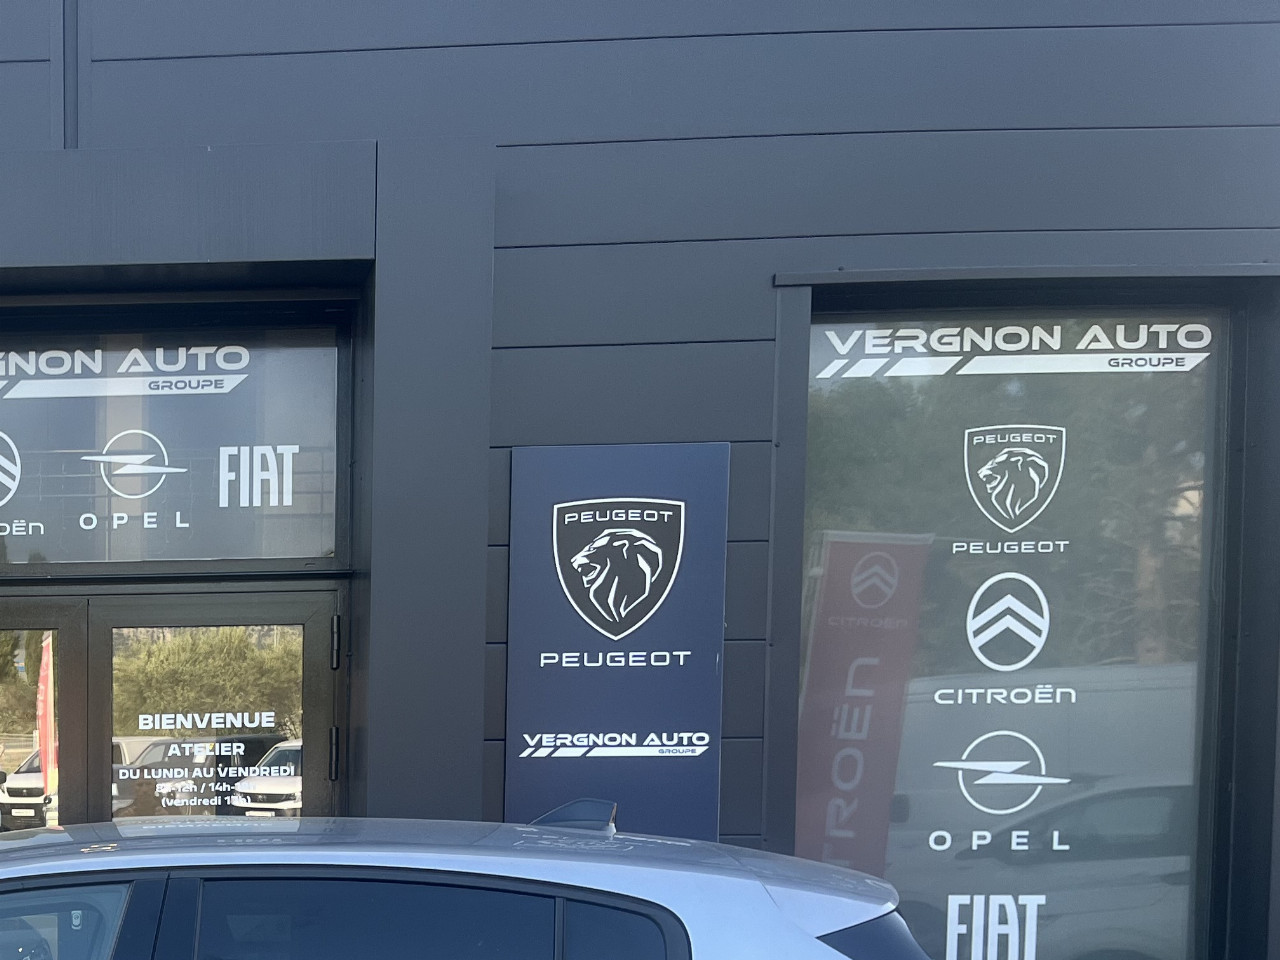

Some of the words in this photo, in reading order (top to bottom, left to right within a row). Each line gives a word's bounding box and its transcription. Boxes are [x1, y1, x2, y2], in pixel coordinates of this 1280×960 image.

[824, 324, 1061, 355] VERGNON
[1075, 323, 1212, 350] AUTO
[116, 345, 250, 374] AUTO
[1107, 357, 1186, 368] GROUPE
[147, 379, 225, 391] GROUPE
[973, 433, 1057, 445] PEUGEOT
[219, 445, 300, 508] FIAT
[79, 511, 190, 531] OPEL
[564, 509, 673, 525] PEUGEOT
[952, 540, 1070, 555] PEUGEOT
[540, 651, 691, 668] PEUGEOT
[934, 684, 1076, 705] CITROËN
[138, 712, 275, 730] BIENVENUE
[523, 732, 637, 747] VERGNON
[642, 732, 710, 747] AUTO
[168, 743, 245, 757] ATELIER
[119, 768, 141, 780] DU
[143, 767, 189, 779] LUNDI
[192, 767, 214, 778] AU
[217, 766, 295, 778] VENDREDI
[161, 796, 222, 808] (vendredi
[928, 830, 1070, 851] OPEL
